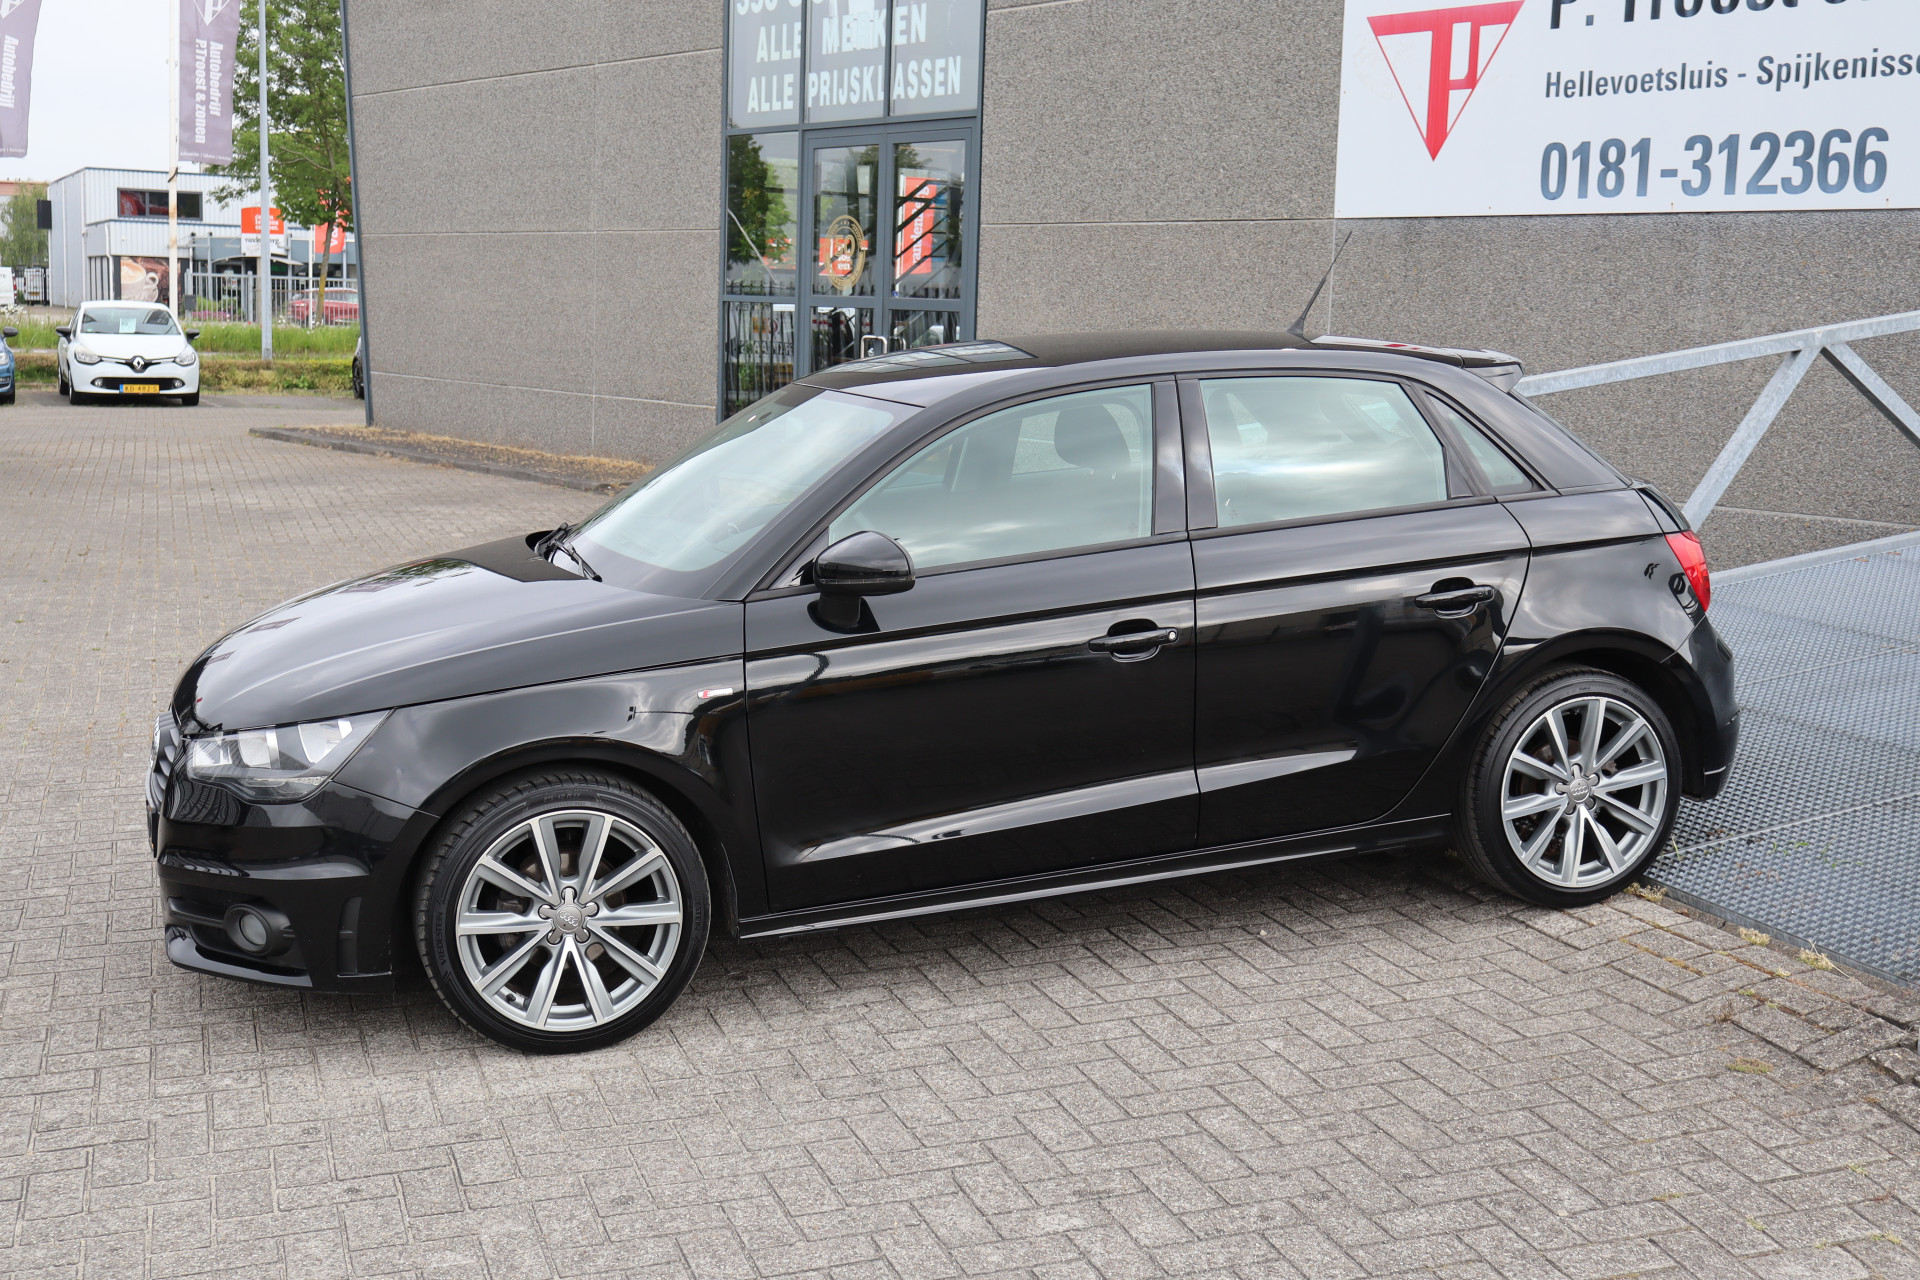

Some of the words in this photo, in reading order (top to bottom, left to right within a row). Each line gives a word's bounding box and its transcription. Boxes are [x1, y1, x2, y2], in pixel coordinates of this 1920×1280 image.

[756, 21, 802, 63] ALLE
[195, 92, 206, 102] &
[208, 41, 224, 117] Autobedrijf
[747, 73, 794, 113] ALLE
[808, 55, 962, 108] PRIJSKLASSEN
[1545, 60, 1728, 98] Hellevoetsluis
[195, 104, 206, 144] zonen
[1540, 127, 1889, 200] 0181-312366
[436, 912, 446, 965] VREDESTEIN
